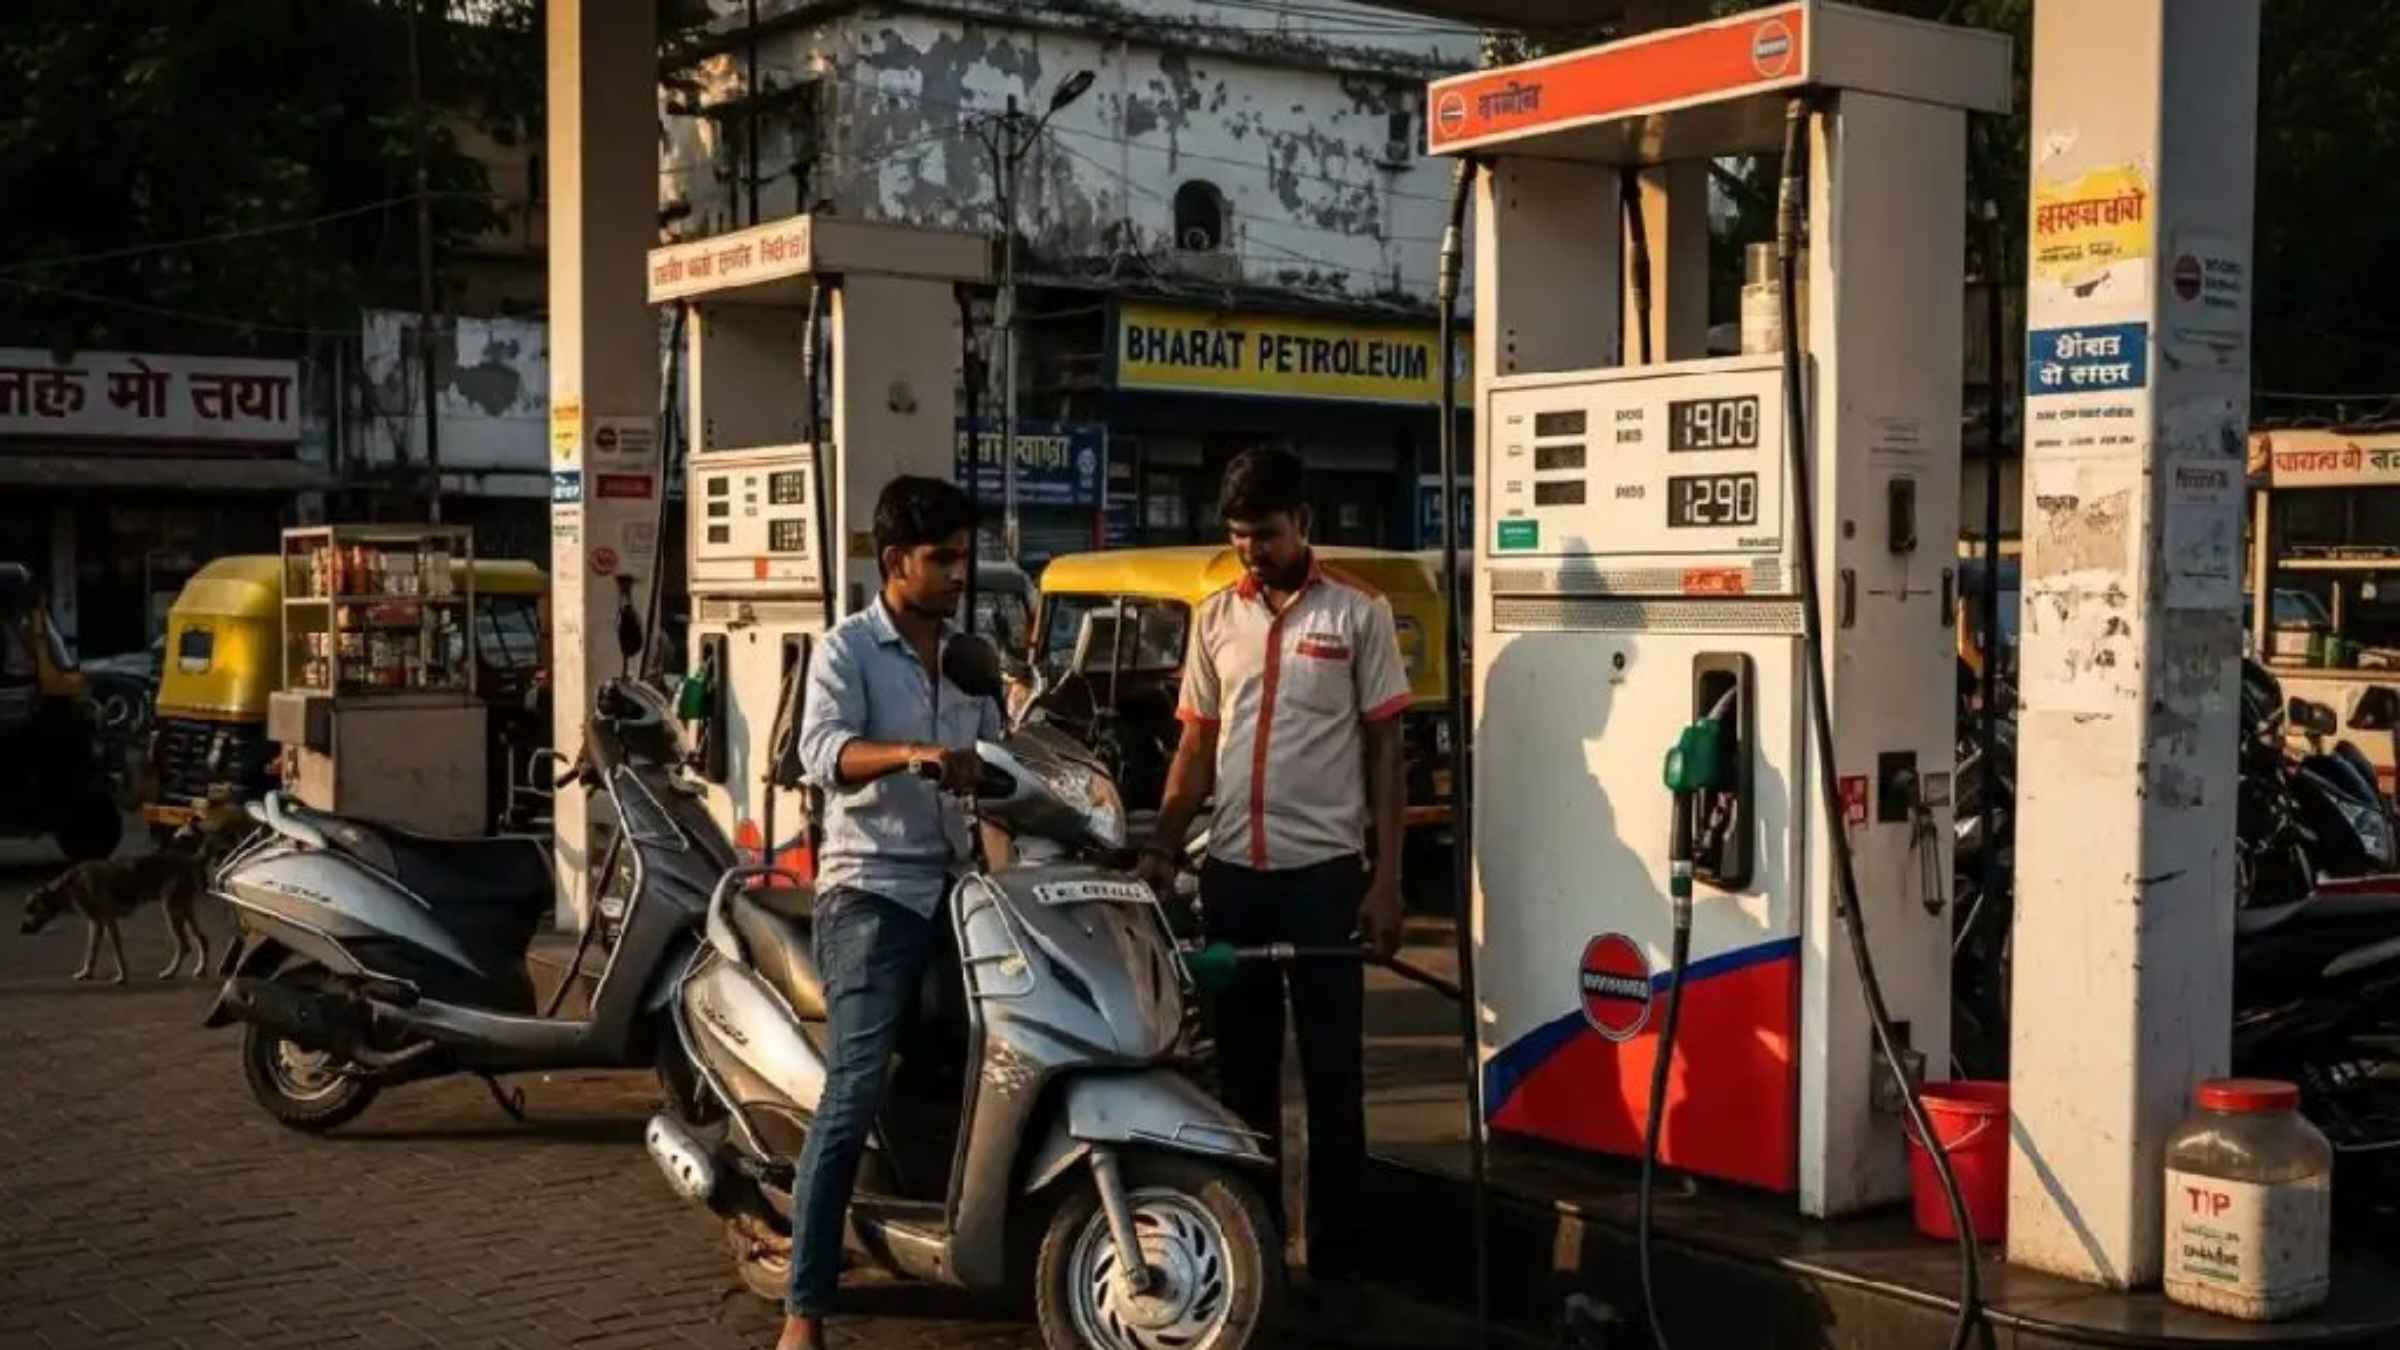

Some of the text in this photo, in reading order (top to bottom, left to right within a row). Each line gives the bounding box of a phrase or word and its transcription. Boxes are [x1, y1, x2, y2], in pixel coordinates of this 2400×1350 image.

[1128, 325, 1428, 380] BHARAT PETROLEUM
[1684, 478, 1755, 523] 1290
[2186, 1186, 2232, 1217] TIP
